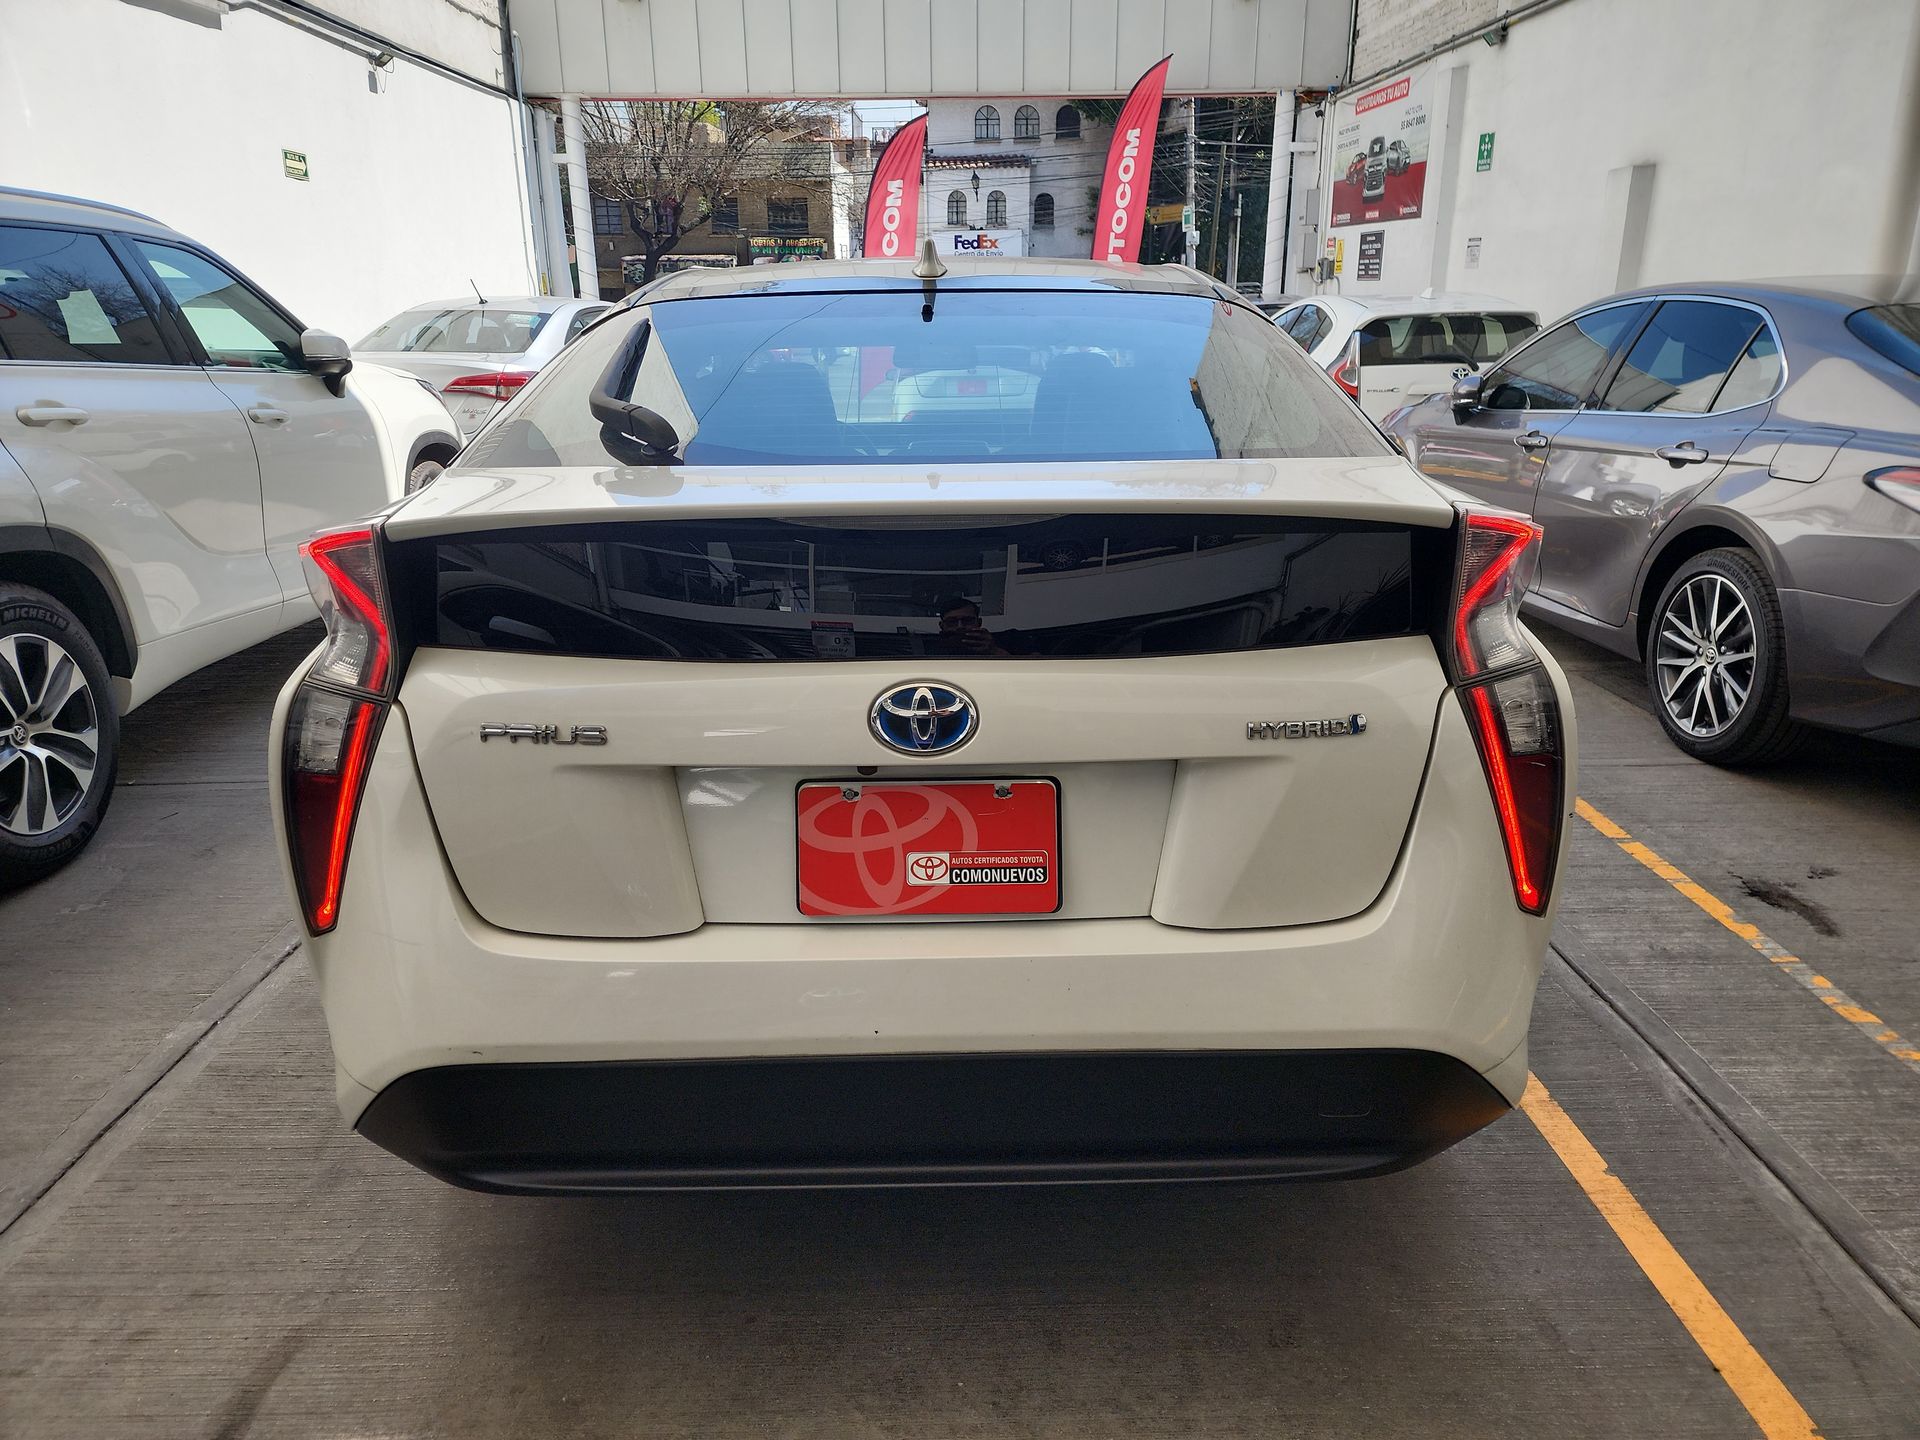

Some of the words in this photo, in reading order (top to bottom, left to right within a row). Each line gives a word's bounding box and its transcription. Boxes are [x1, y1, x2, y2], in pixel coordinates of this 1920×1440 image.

[881, 179, 904, 257] COM
[954, 234, 999, 250] FedEx
[3, 607, 67, 629] MICHELIN
[480, 722, 607, 745] PRIUS
[1246, 719, 1348, 740] HYBRID
[951, 857, 973, 865] AUTOS
[974, 856, 1018, 865] CERTIFICADOS
[1020, 856, 1044, 864] TOYOTA
[952, 867, 1045, 883] COMONUEVOS
